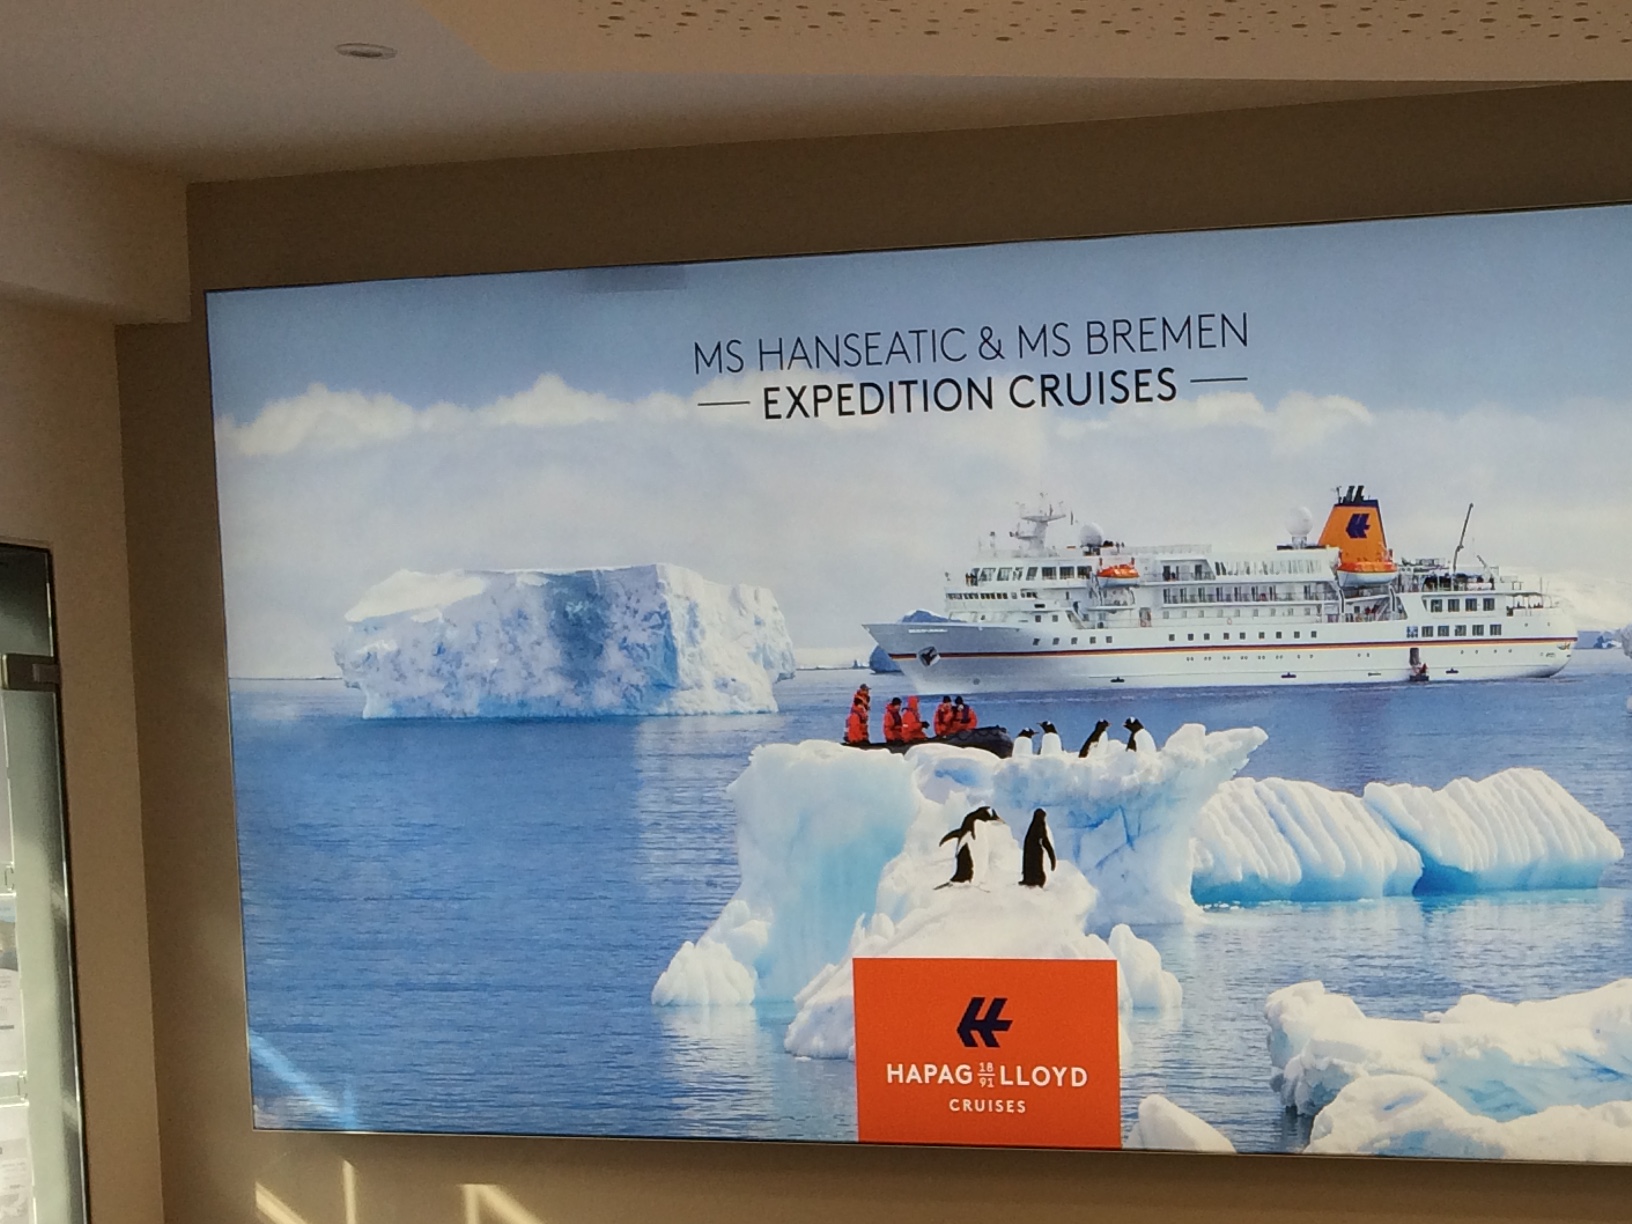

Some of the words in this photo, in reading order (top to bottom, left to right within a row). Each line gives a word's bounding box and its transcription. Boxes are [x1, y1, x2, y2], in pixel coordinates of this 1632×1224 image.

[693, 339, 745, 375] MS
[758, 327, 968, 371] HANSEATIC
[978, 326, 1005, 360] &
[1018, 322, 1071, 359] MS
[1087, 312, 1248, 355] BREMEN
[763, 376, 994, 420] EXPEDITION
[1008, 367, 1177, 409] CRUISES
[886, 1063, 974, 1085] HAPAG
[999, 1065, 1088, 1087] LLOYD
[949, 1098, 1027, 1114] CRUISES
